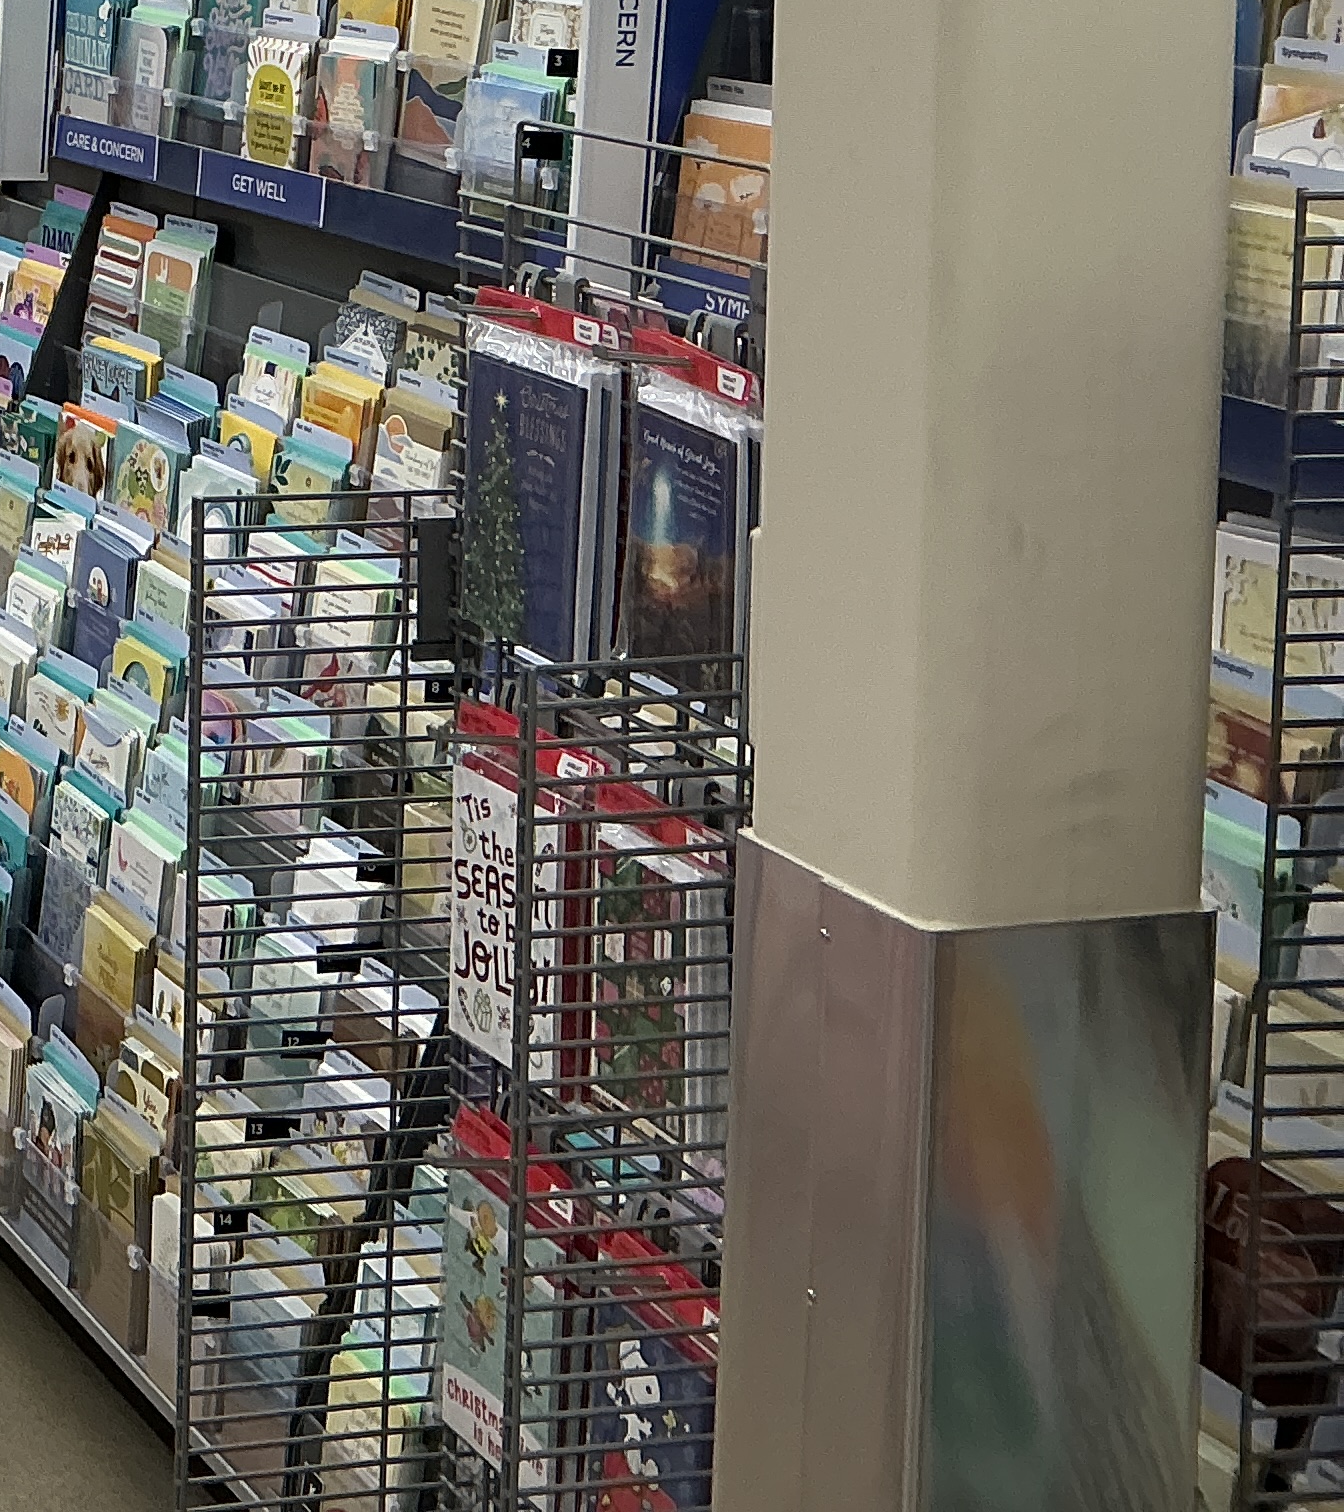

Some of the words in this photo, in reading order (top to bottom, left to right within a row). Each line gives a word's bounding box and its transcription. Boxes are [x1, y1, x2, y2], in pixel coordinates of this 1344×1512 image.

[554, 54, 563, 67] 3
[66, 130, 91, 152] CARE
[91, 137, 99, 153] &
[99, 139, 145, 164] CONCERN
[521, 137, 531, 149] 4
[232, 173, 254, 194] GET
[255, 177, 287, 203] WELL
[431, 681, 440, 694] 8
[457, 793, 492, 824] 'Tis
[479, 830, 514, 867] the
[477, 906, 501, 936] to
[286, 1036, 300, 1047] 12
[250, 1123, 264, 1135] 13
[219, 1213, 233, 1226] 14
